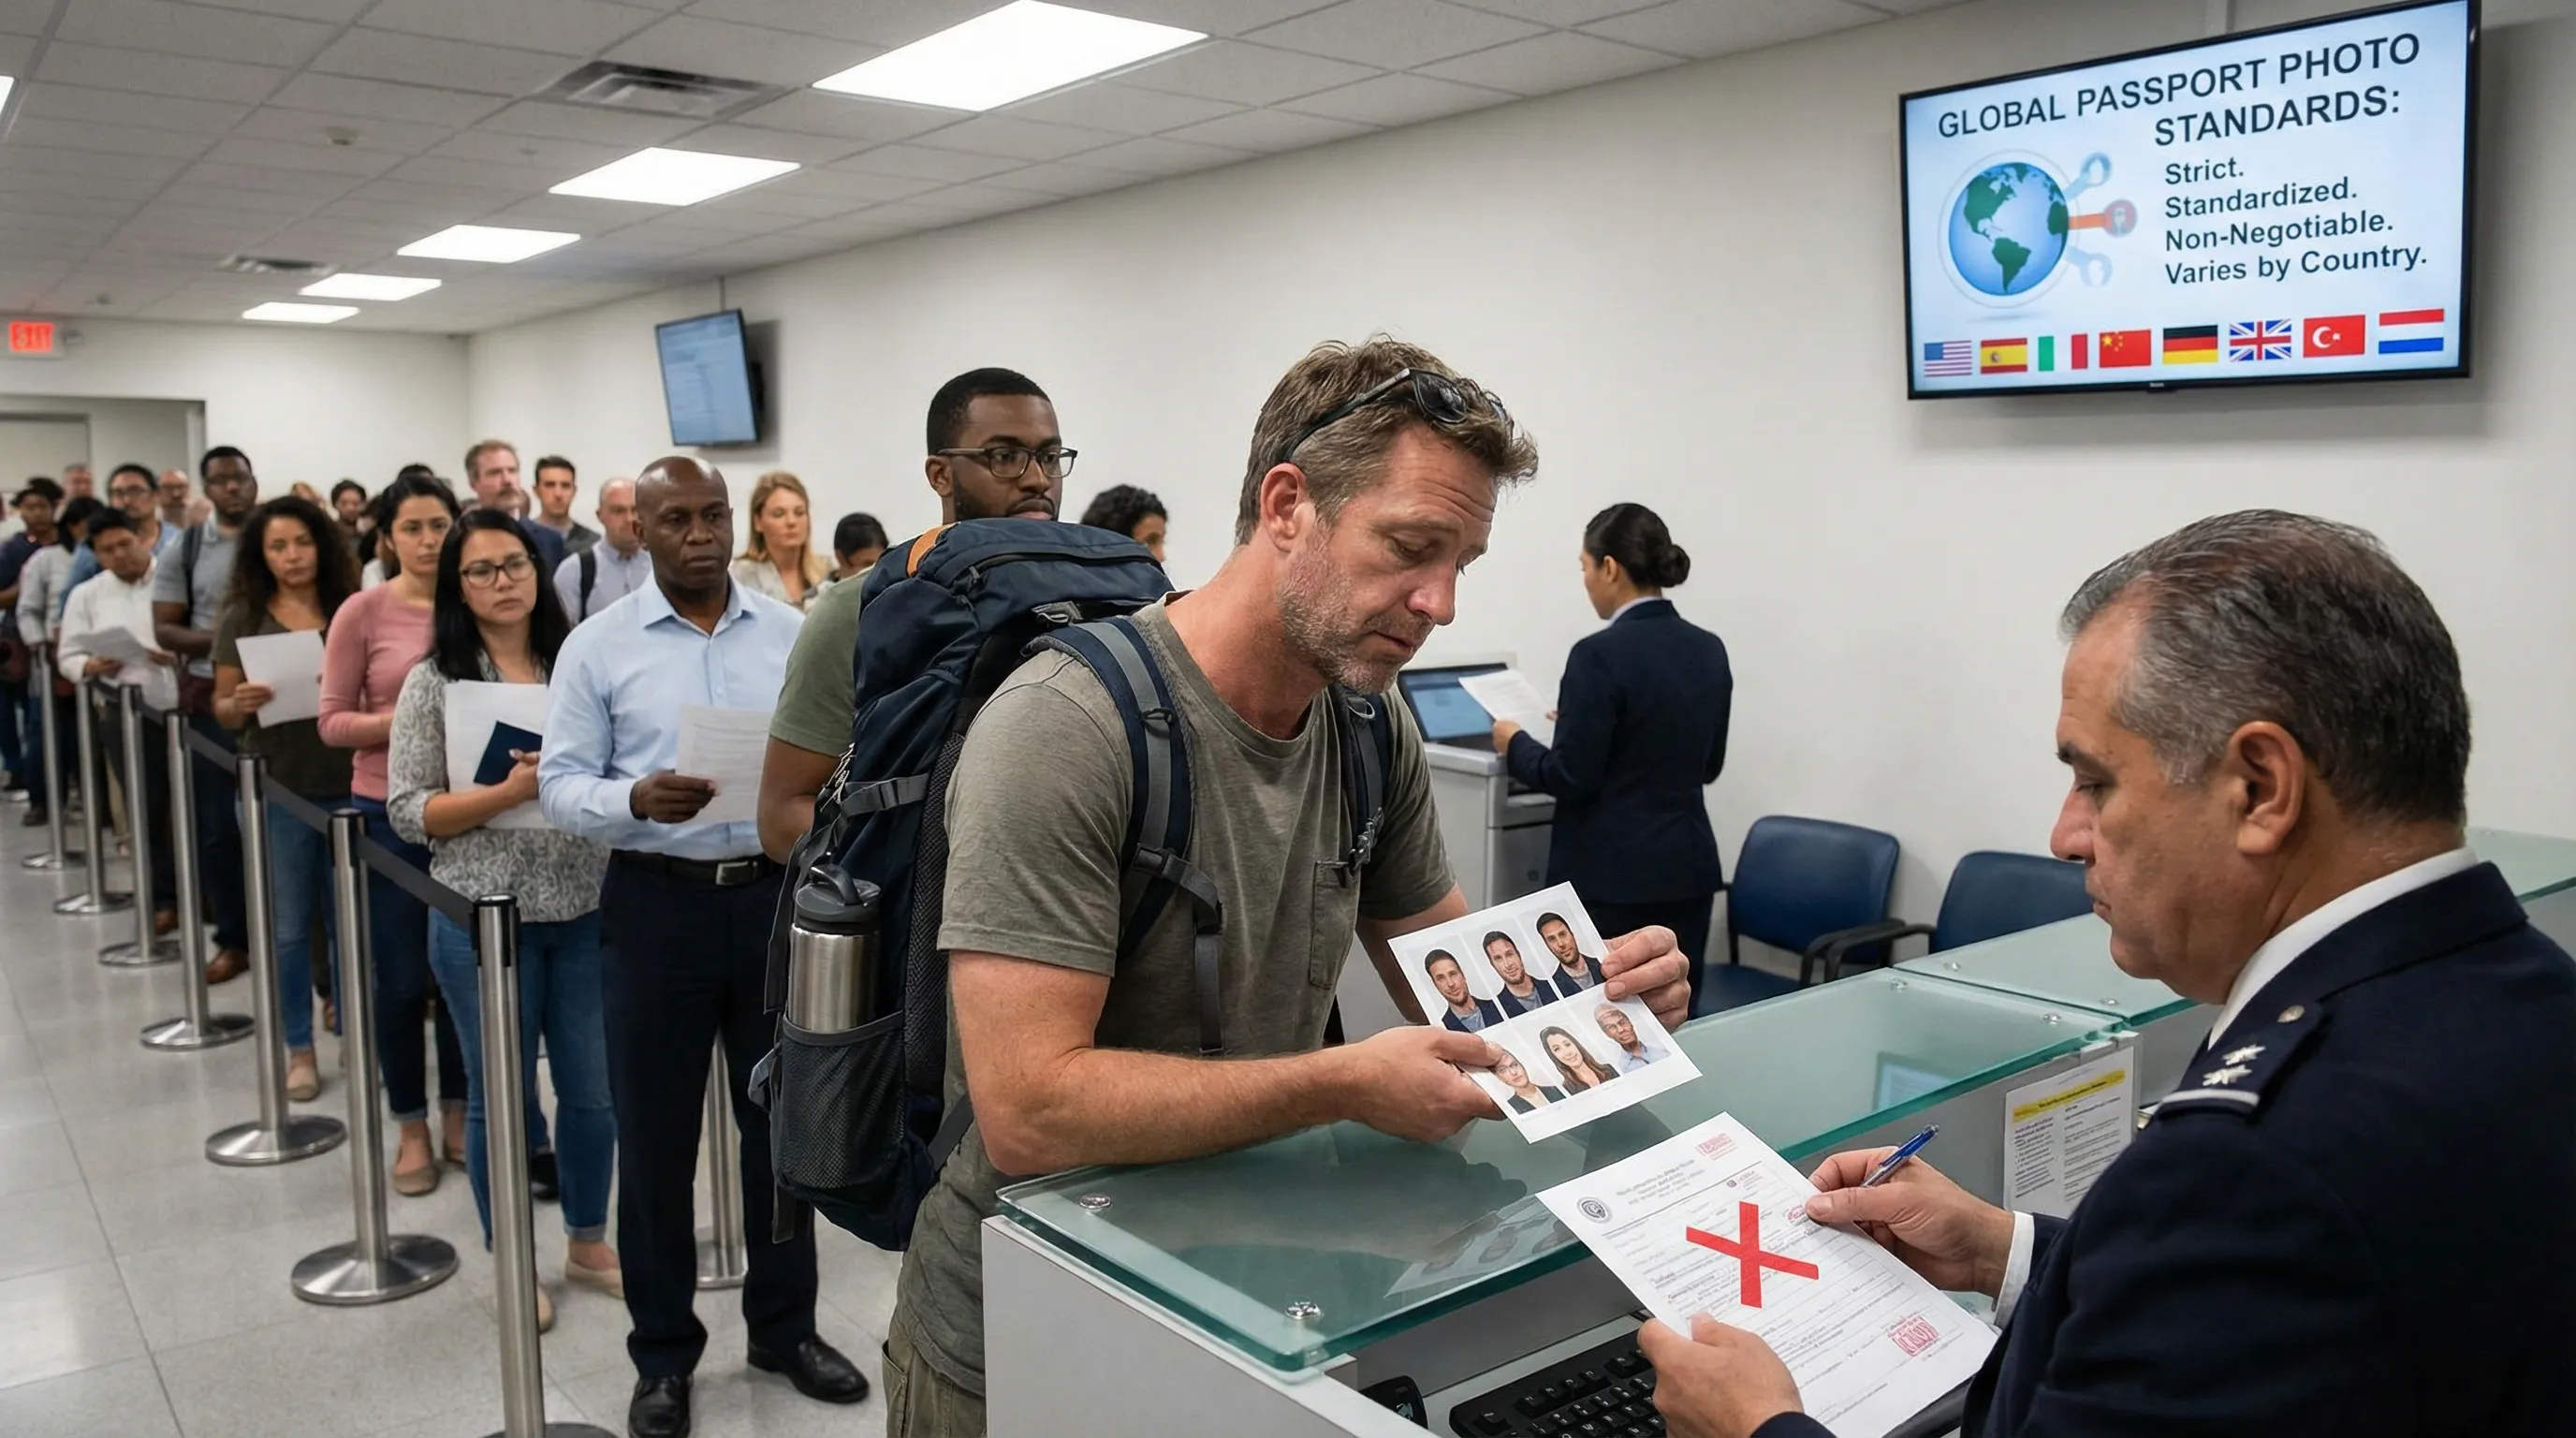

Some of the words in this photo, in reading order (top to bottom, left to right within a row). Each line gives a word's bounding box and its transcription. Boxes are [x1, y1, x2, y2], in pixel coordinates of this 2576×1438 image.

[1938, 95, 2066, 139] GLOBAL
[2077, 58, 2267, 117] PASSPORT
[2280, 33, 2420, 84] PHOTO
[2155, 85, 2399, 146] STANDARDS:
[2165, 157, 2245, 185] Strict.
[2165, 176, 2357, 218] Standardized.
[2166, 210, 2393, 252] Non-Negotiable.
[2165, 259, 2247, 285] Varies
[2259, 256, 2291, 282] by
[2301, 245, 2427, 273] Country.
